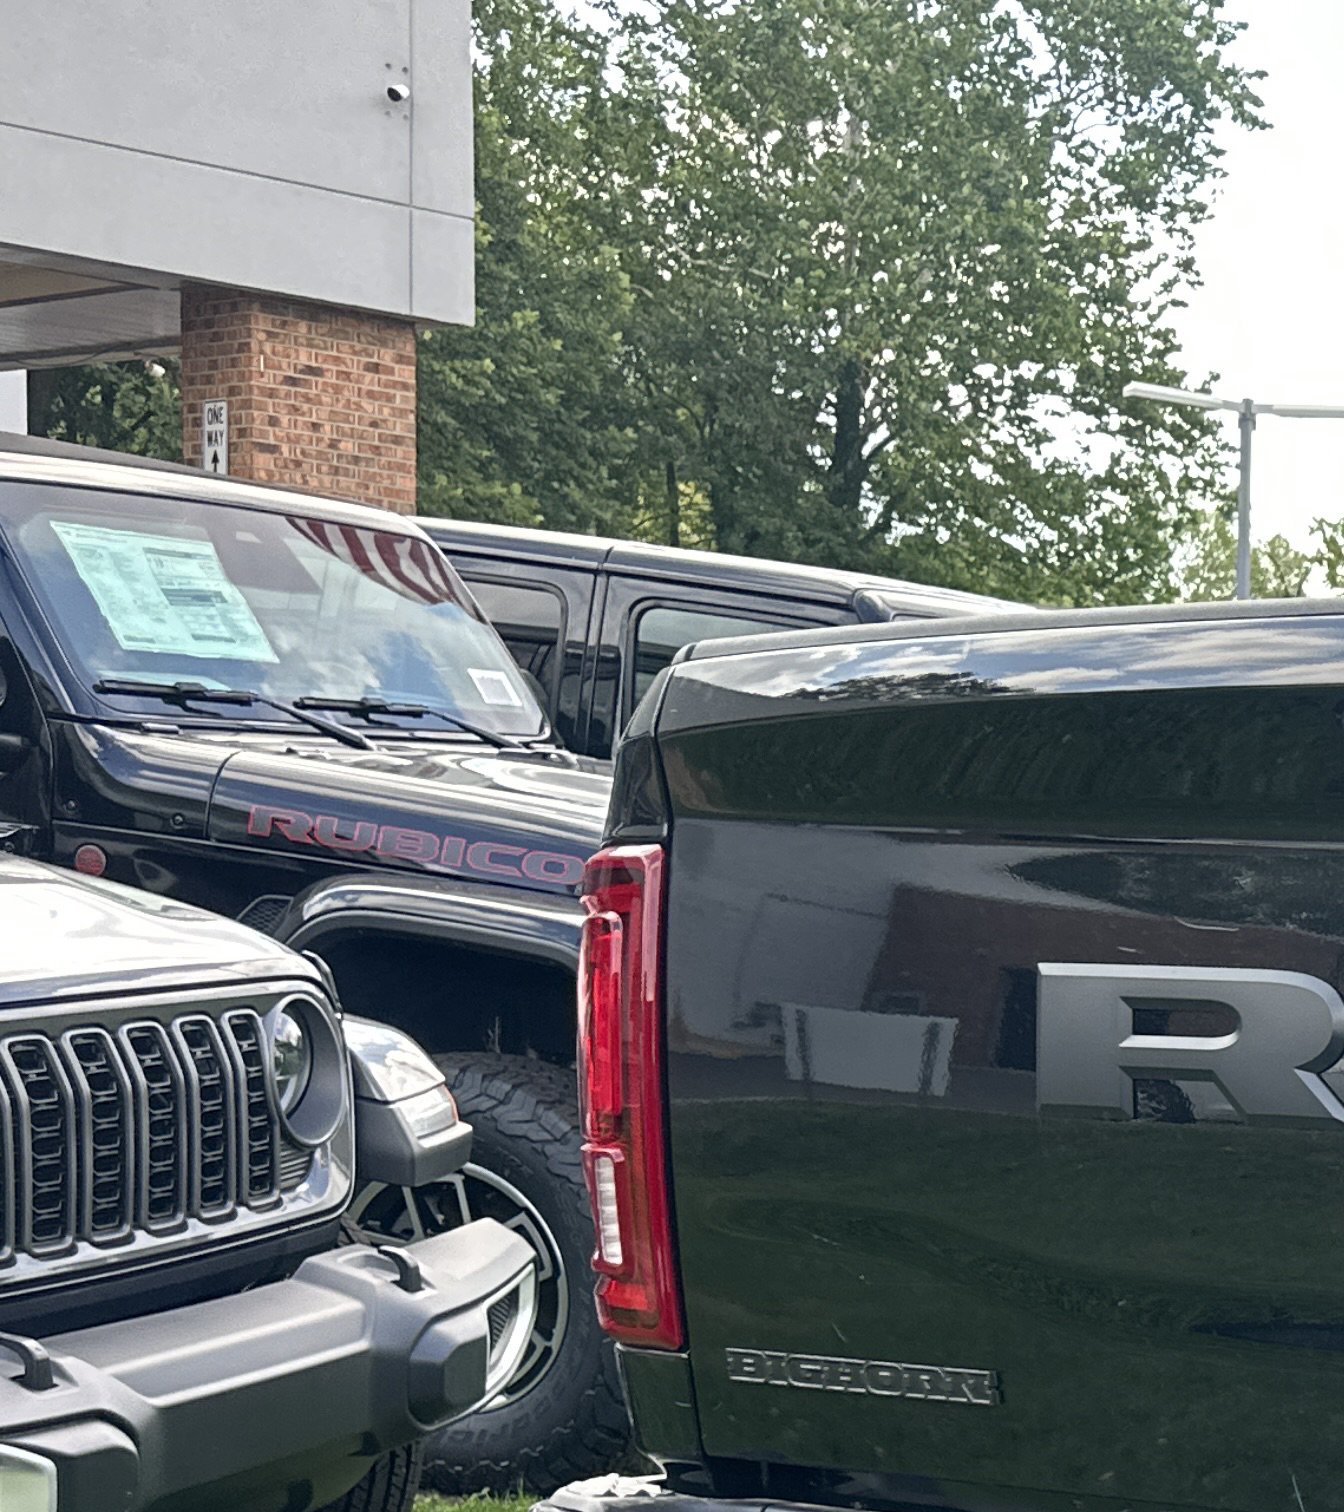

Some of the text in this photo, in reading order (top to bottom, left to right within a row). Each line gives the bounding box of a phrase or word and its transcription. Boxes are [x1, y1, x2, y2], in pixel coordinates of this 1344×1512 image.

[206, 405, 224, 426] ONE
[206, 429, 224, 448] WAY
[247, 804, 588, 886] RUBICO
